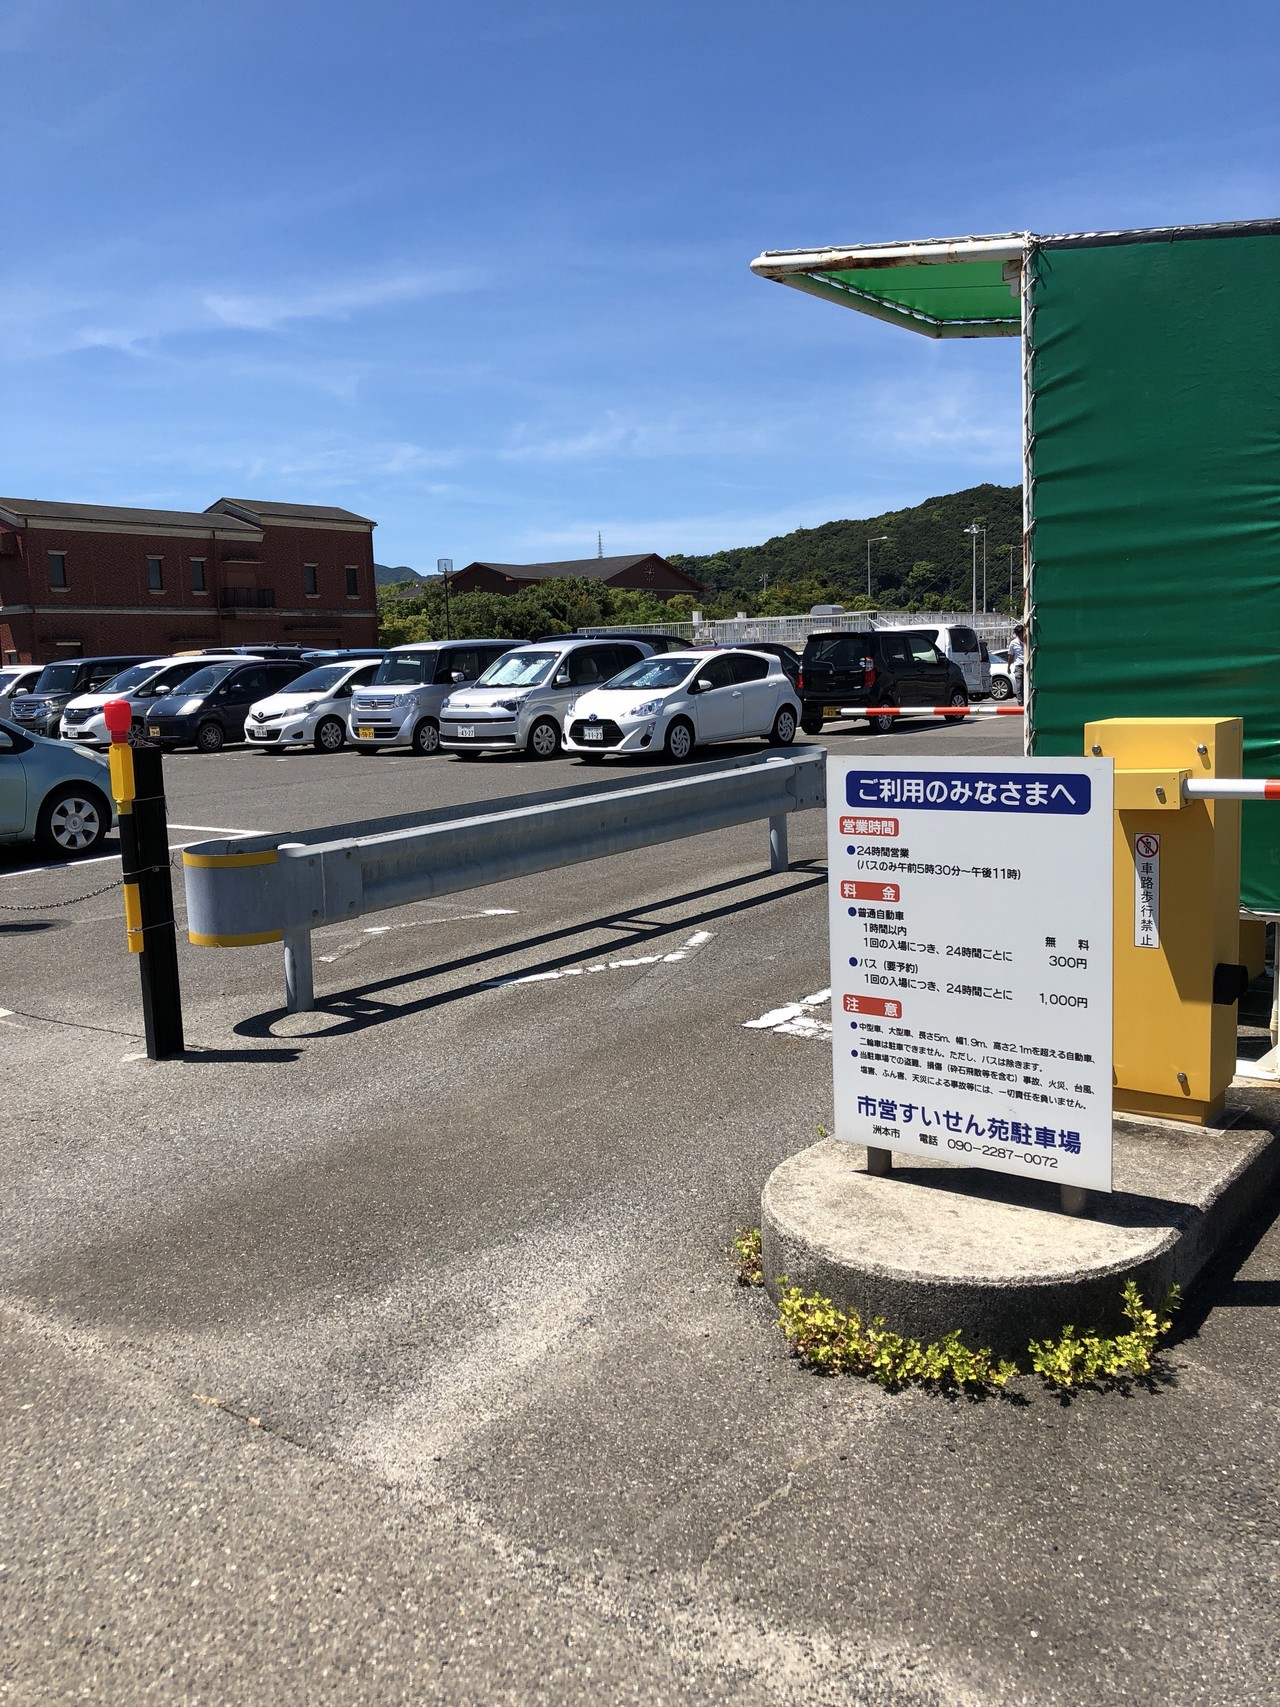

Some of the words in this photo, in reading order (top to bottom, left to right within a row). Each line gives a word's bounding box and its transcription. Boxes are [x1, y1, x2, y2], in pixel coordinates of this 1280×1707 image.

[858, 778, 1076, 806] ご利用のみなさまへ
[842, 818, 895, 836] 営業時間
[857, 845, 910, 859] 24時間営業
[857, 907, 905, 921] 普通自動車
[1140, 861, 1154, 947] 車路歩行禁止
[863, 922, 907, 937] 1時間以内
[863, 937, 1013, 962] 1回の入場につき、24時間ごとに
[1048, 955, 1088, 970] 300円
[864, 973, 1013, 1001] 1回の入場につき、24時間ごとに
[1039, 993, 1088, 1009] 1,000円
[859, 1037, 1043, 1072] 二輪車は駐車できません。ただし、バスは除きます。
[857, 1095, 1081, 1155] 市営すいせん苑駐車場
[872, 1124, 901, 1139] 洲本市
[919, 1133, 938, 1147] 電話
[947, 1138, 1058, 1169] 090-2287-0072
